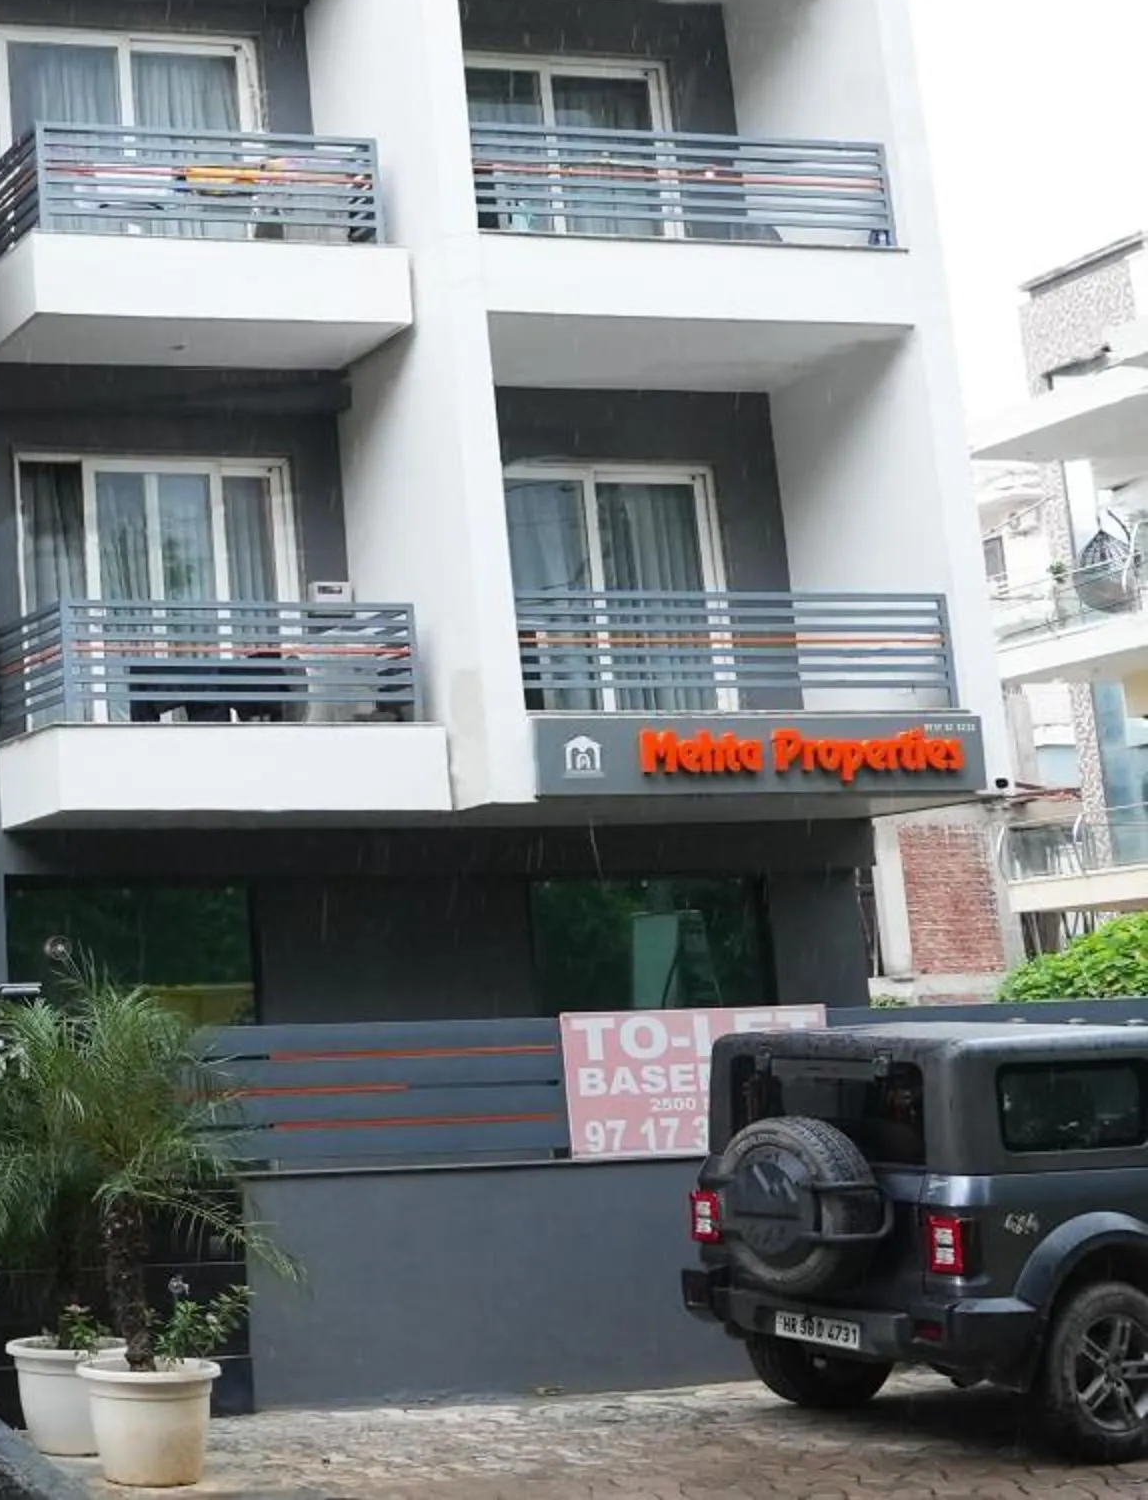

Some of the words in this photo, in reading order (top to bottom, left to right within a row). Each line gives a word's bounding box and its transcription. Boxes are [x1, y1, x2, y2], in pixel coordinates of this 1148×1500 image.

[639, 727, 764, 774] Mehta
[771, 727, 965, 786] Properties
[651, 1097, 697, 1112] 2500
[585, 1119, 627, 1153] 97
[639, 1117, 680, 1151] 17
